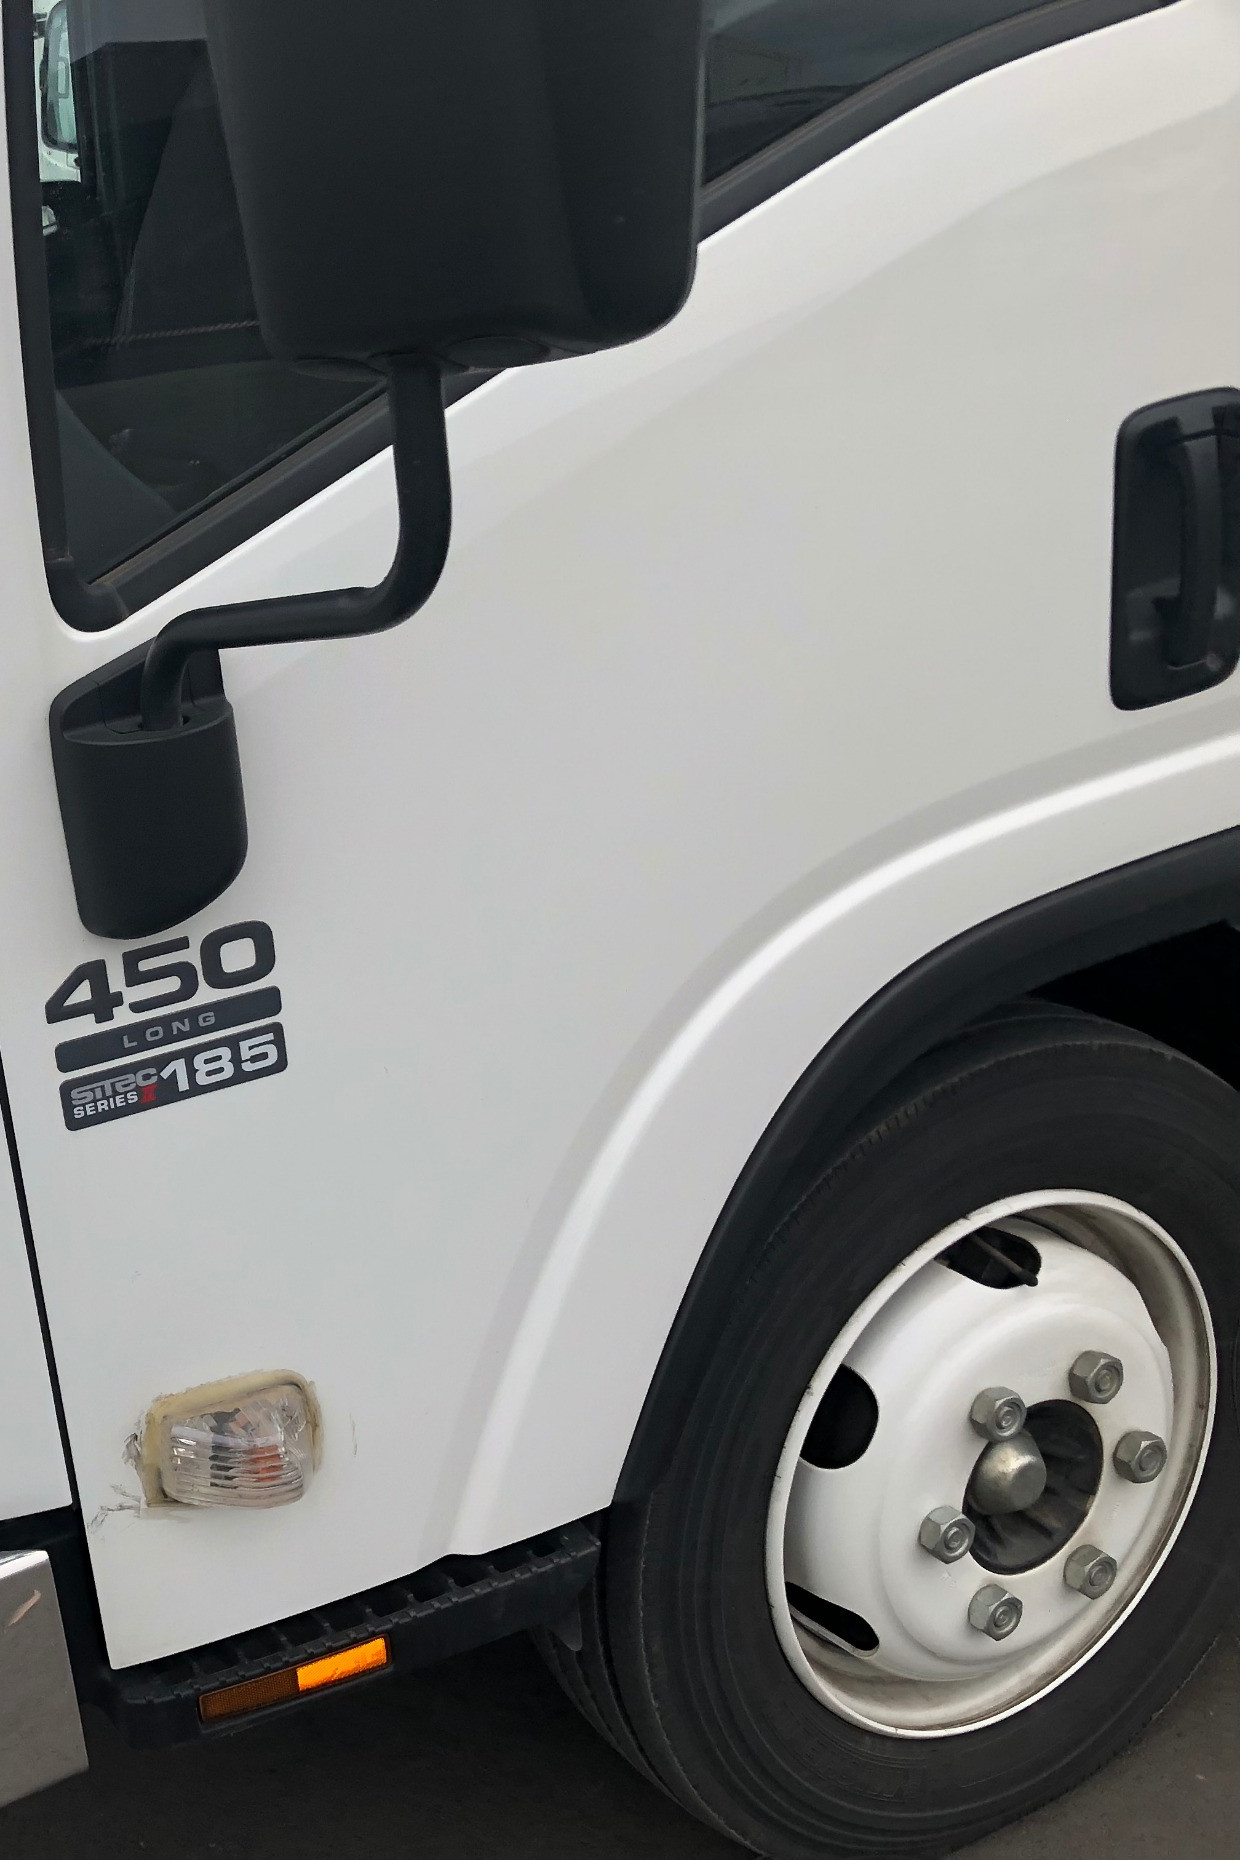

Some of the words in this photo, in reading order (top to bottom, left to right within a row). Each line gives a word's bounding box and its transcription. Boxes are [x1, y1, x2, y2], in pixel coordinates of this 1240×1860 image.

[45, 920, 276, 1024] 450
[123, 1011, 216, 1049] LONG
[160, 1033, 279, 1092] 185
[73, 1091, 139, 1119] SERIES
